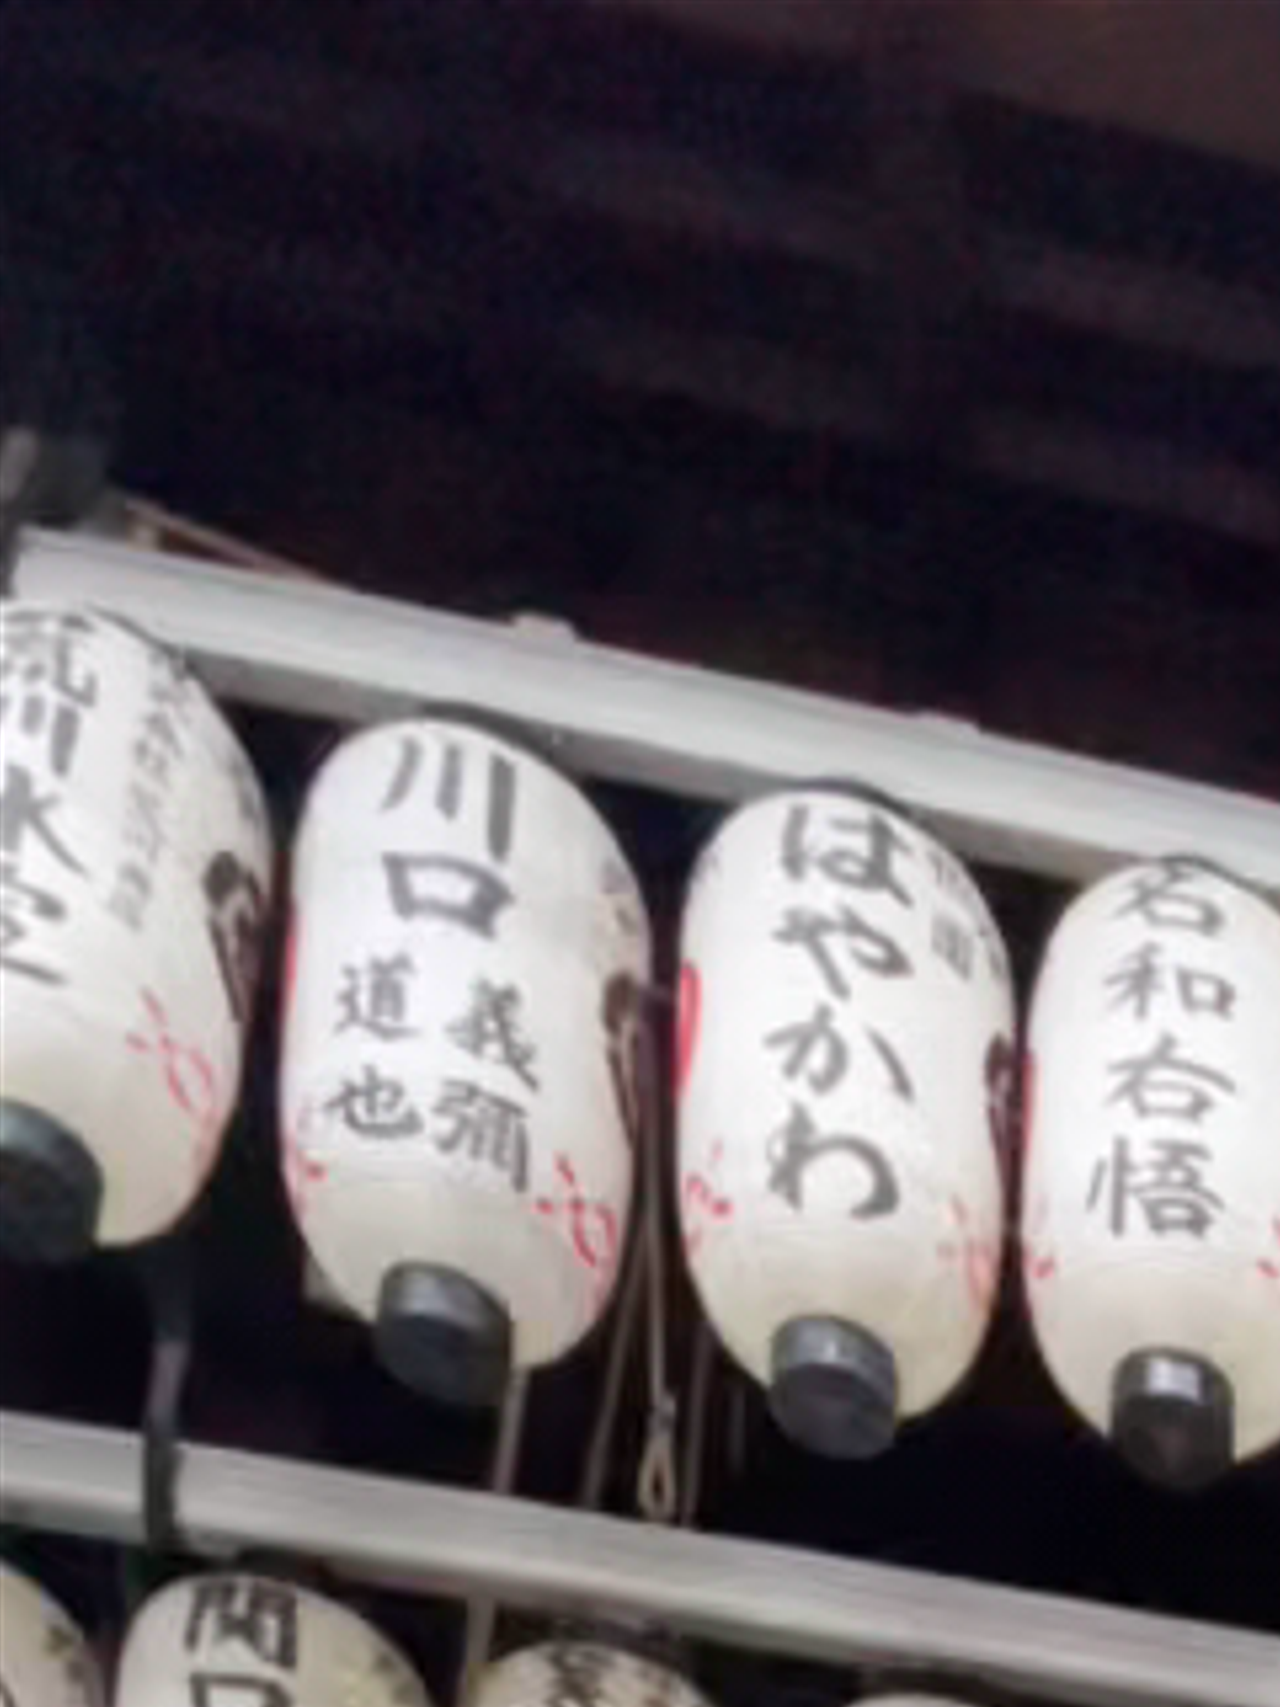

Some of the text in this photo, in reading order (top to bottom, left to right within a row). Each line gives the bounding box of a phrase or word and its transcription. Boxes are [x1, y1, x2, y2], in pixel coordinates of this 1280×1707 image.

[382, 734, 520, 942] 川口
[320, 950, 422, 1143] 道也
[760, 802, 916, 1224] はやかわ
